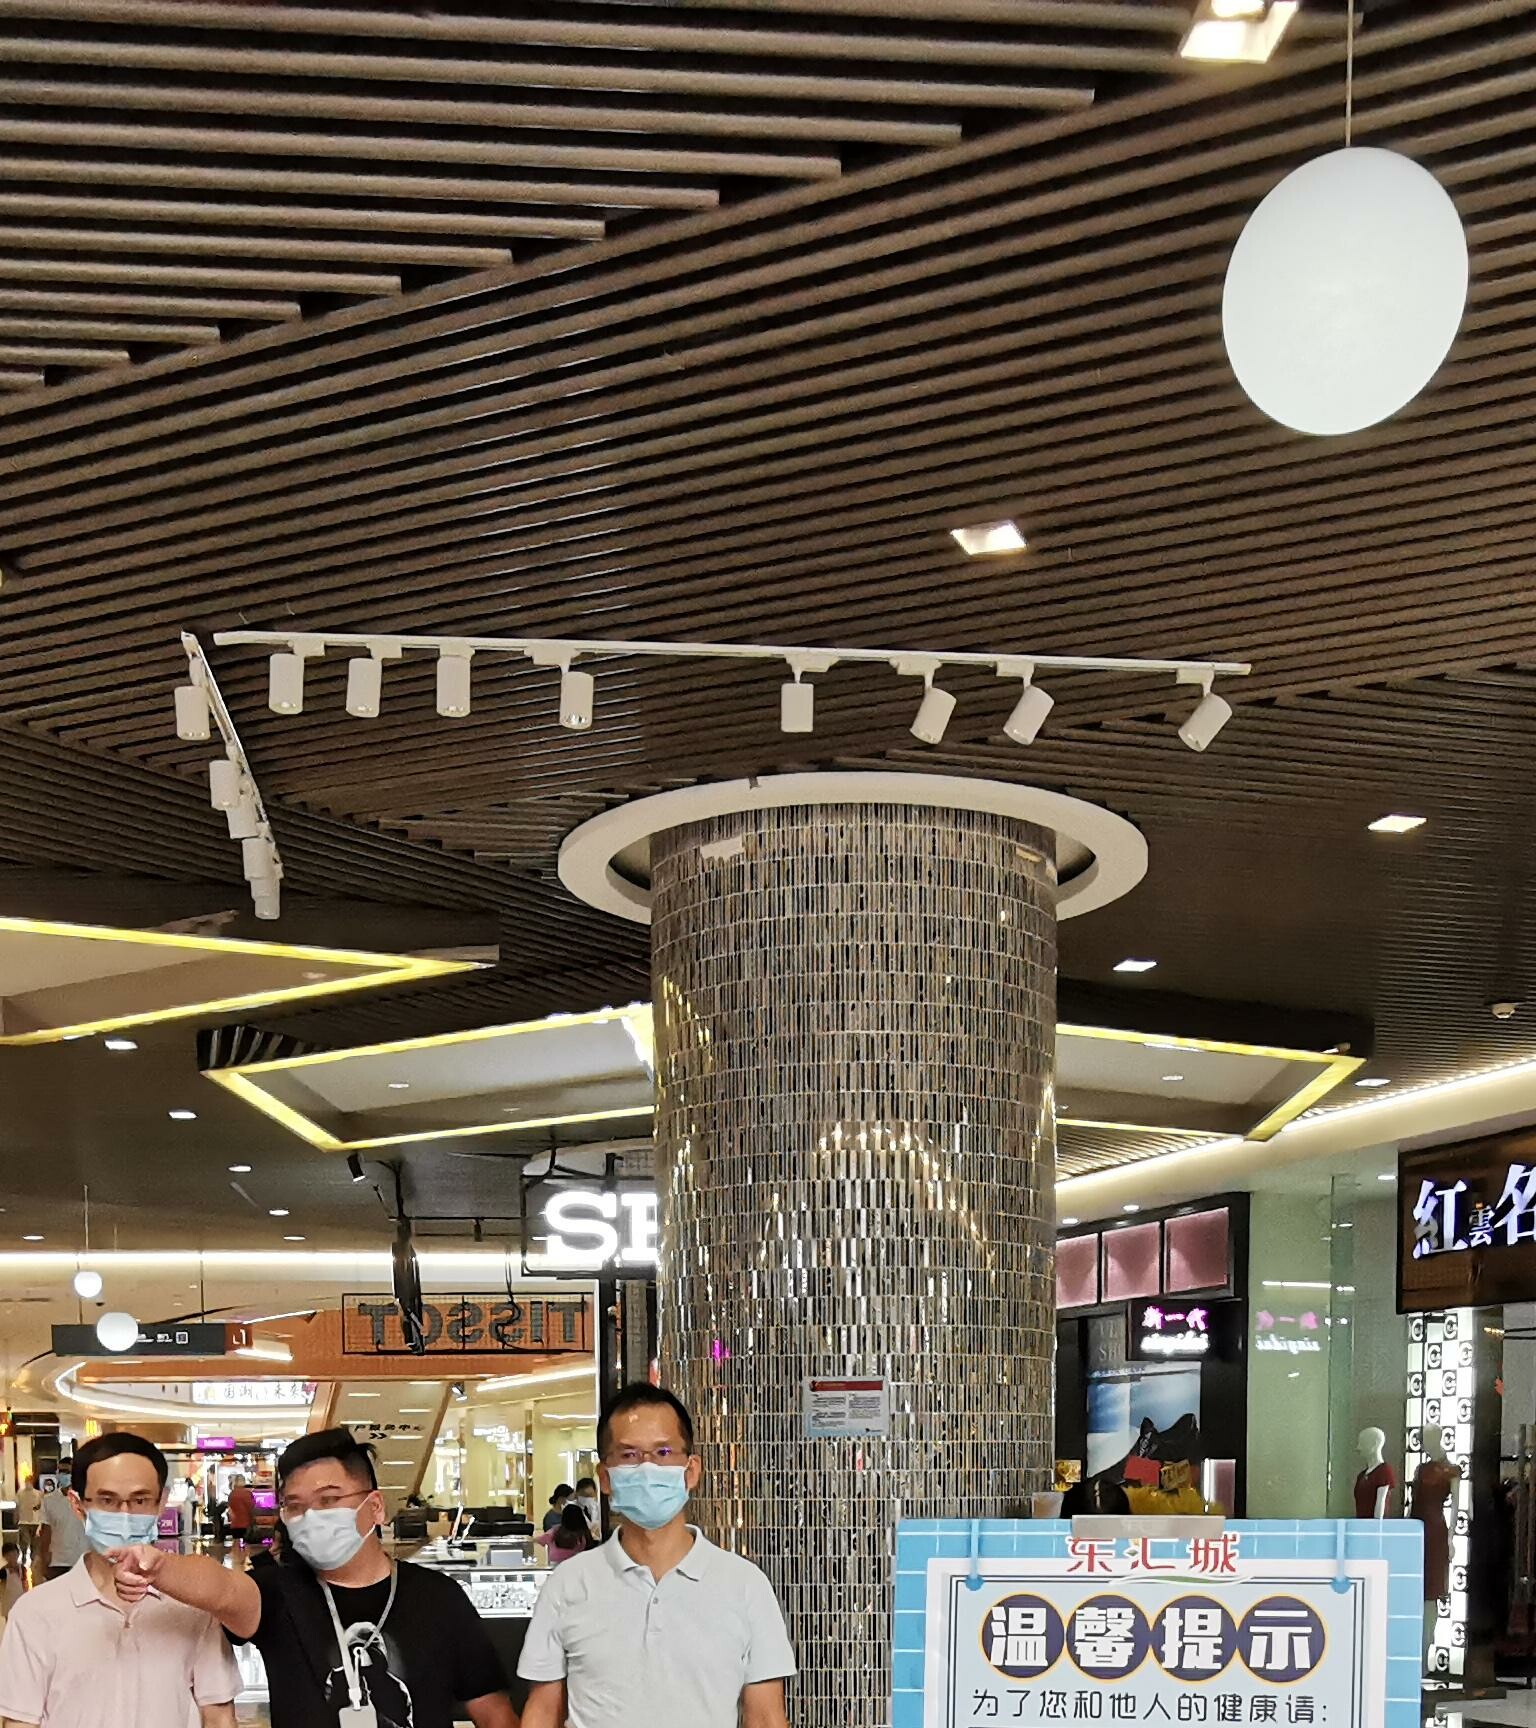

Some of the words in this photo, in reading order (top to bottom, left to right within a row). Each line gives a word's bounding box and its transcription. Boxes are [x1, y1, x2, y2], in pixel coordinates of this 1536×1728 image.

[1067, 1534, 1238, 1573] 东汇城
[990, 1604, 1313, 1671] 温馨提示
